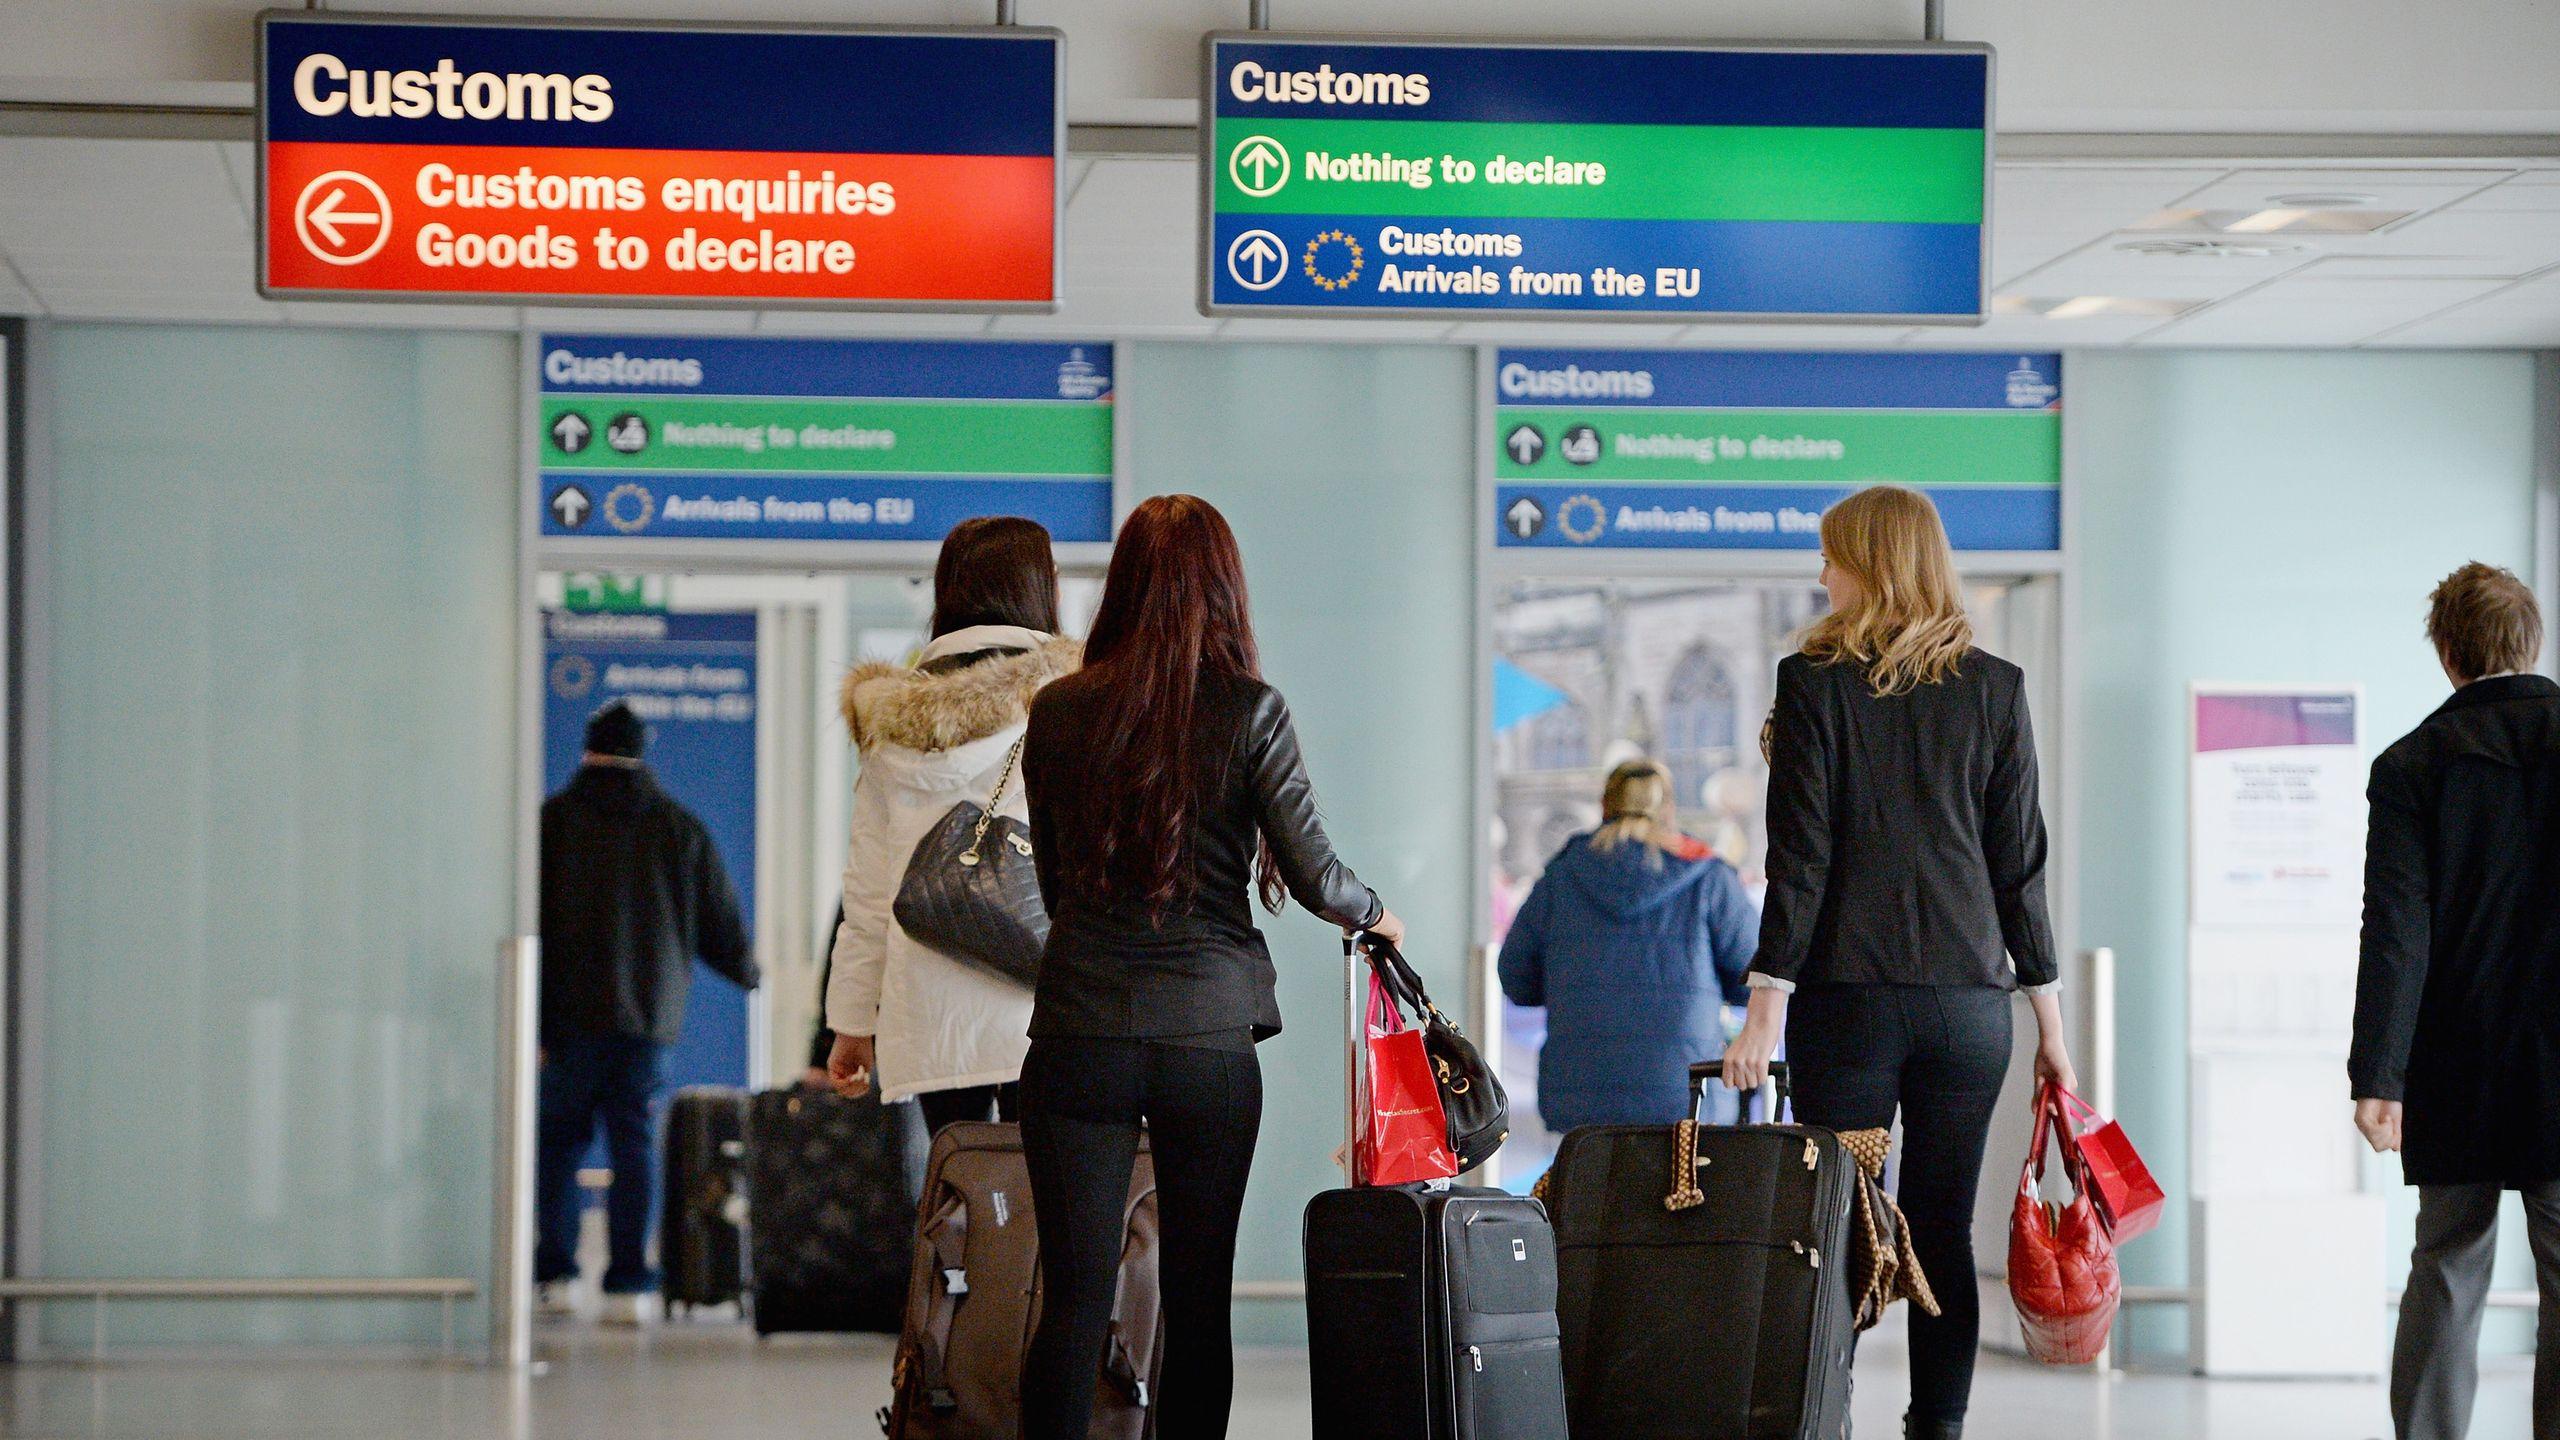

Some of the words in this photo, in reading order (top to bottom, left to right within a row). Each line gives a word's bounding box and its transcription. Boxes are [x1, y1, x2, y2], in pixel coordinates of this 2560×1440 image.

[294, 54, 614, 123] Customs
[1230, 61, 1431, 107] Customs
[1306, 152, 1432, 190] Nothing
[1441, 155, 1477, 184] to
[1485, 155, 1607, 187] declare
[417, 163, 646, 212] Customs
[662, 170, 897, 223] enquiries
[416, 223, 579, 271] Goods
[594, 228, 650, 272] to
[665, 230, 857, 275] declare
[1379, 226, 1523, 258] Customs
[1378, 264, 1502, 296] Arrivals
[1509, 267, 1583, 297] from
[1591, 268, 1646, 298] the
[1656, 269, 1701, 299] EU
[545, 349, 704, 388] Customs
[1499, 361, 1656, 399] Customs
[663, 421, 765, 456] Nothing
[768, 424, 796, 450] to
[800, 424, 897, 452] declare
[1615, 433, 1716, 465] Nothing
[1719, 436, 1747, 460] to
[1749, 435, 1846, 461] declare
[662, 494, 759, 522] Arrivals
[762, 495, 824, 523] from
[827, 496, 873, 524] the
[876, 498, 915, 525] EU
[1615, 505, 1711, 534] Arrivals
[1714, 506, 1775, 534] from
[1777, 507, 1819, 535] the
